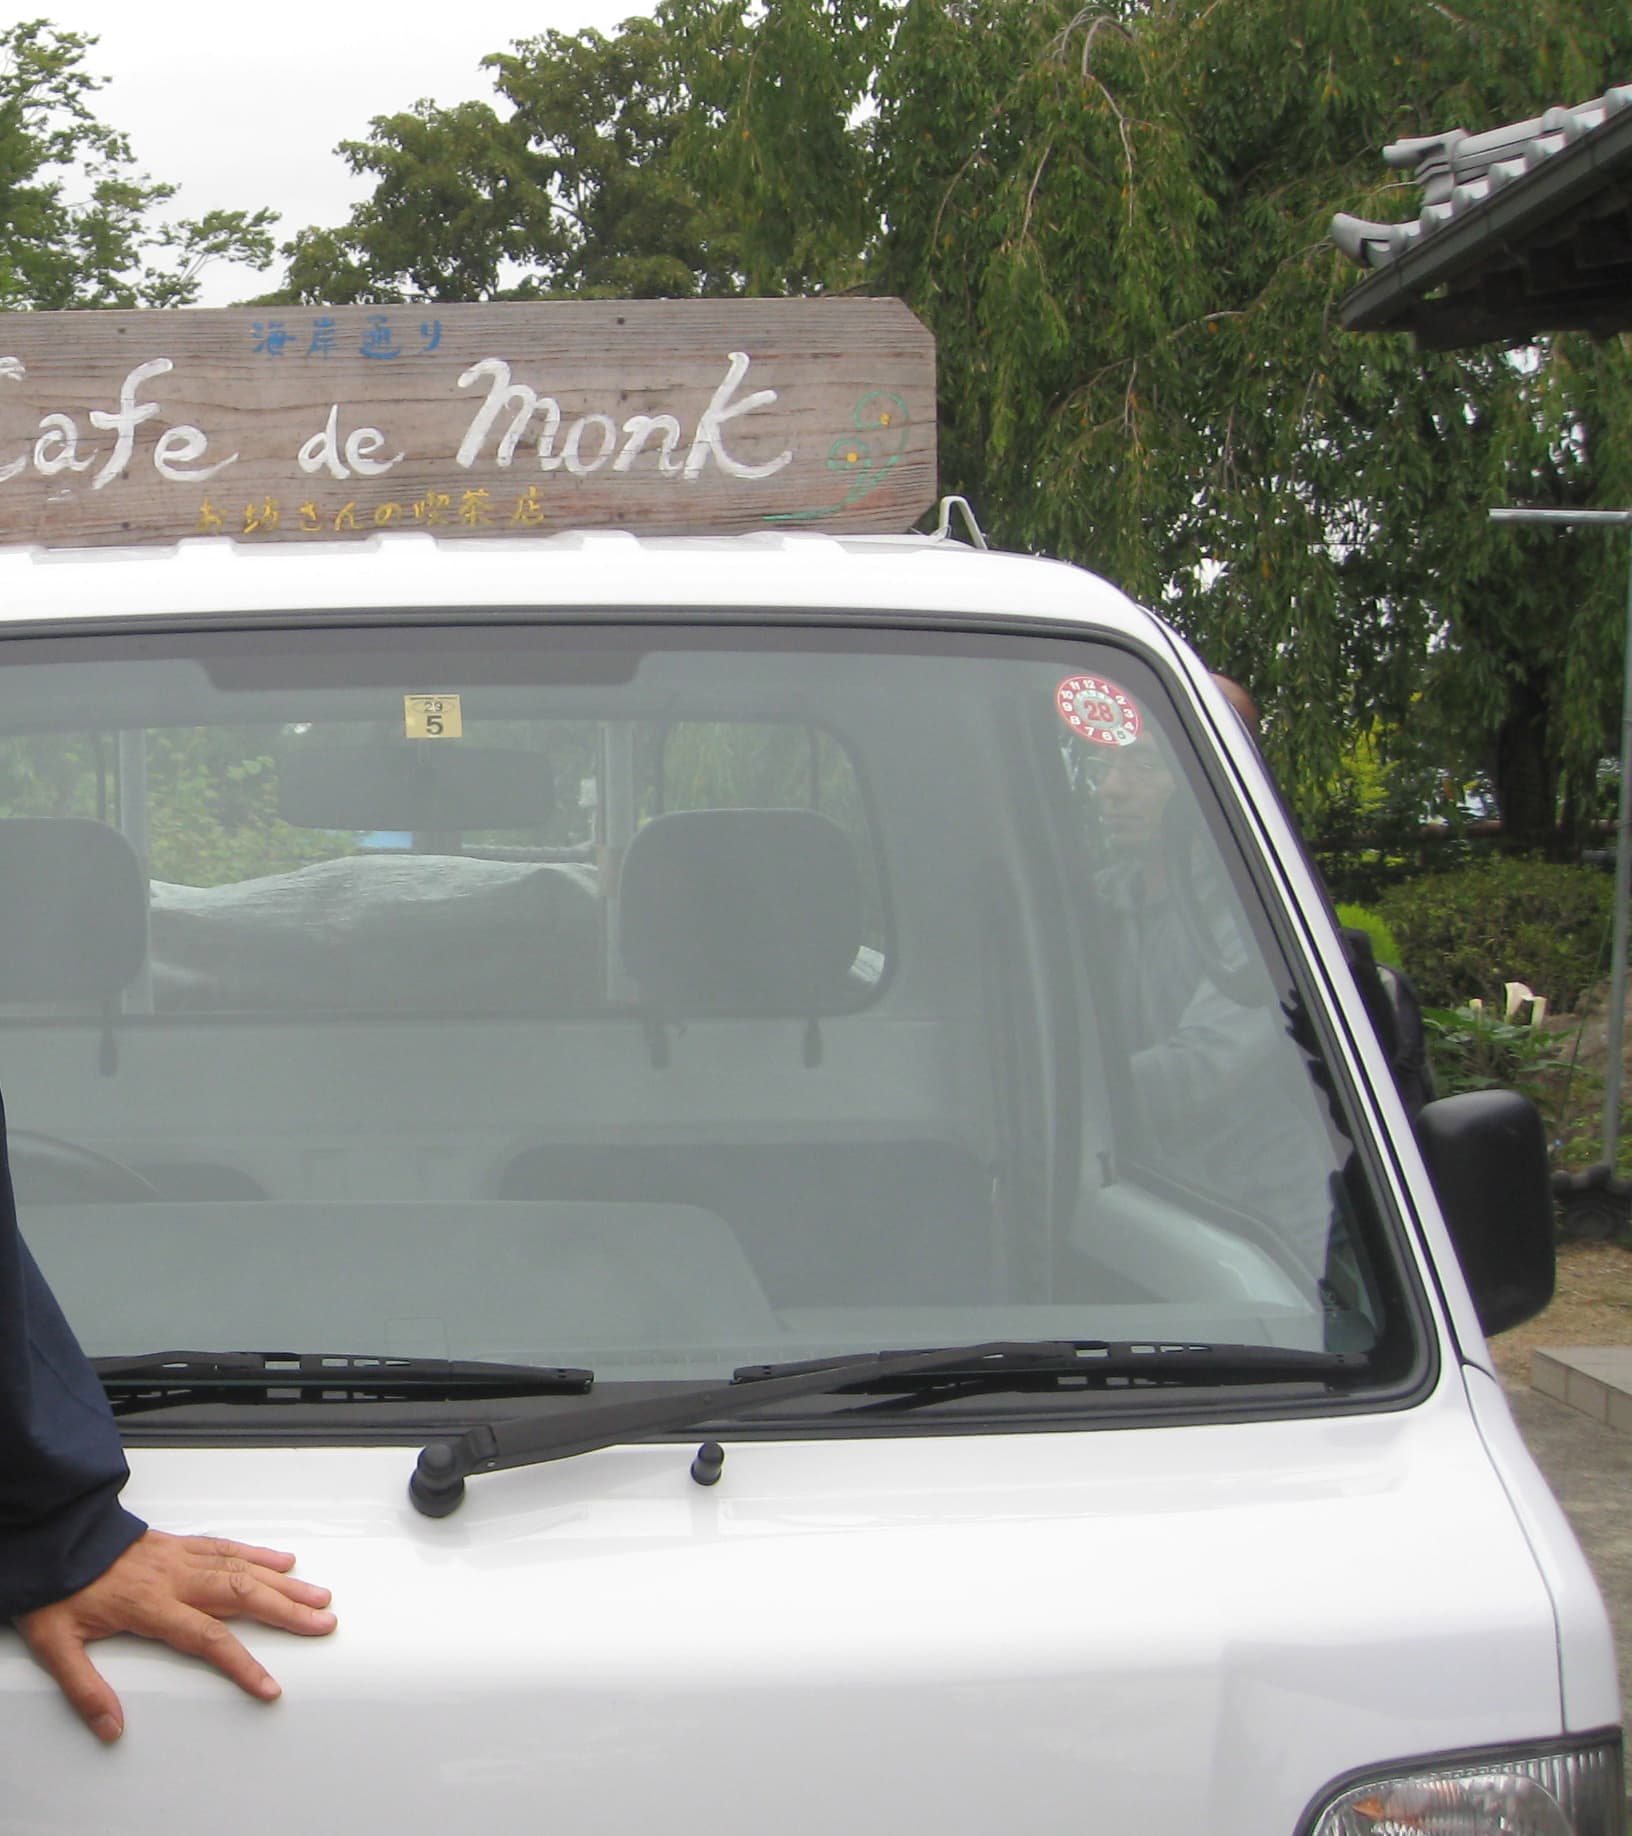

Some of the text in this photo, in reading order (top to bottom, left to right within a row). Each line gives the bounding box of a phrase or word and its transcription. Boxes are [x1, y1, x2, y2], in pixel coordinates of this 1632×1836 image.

[250, 314, 443, 361] 海岸通り
[297, 403, 405, 480] de
[455, 351, 793, 481] Monk
[197, 485, 545, 535] お坊さんの喫茶店
[426, 715, 444, 736] 5
[1083, 700, 1115, 723] 28
